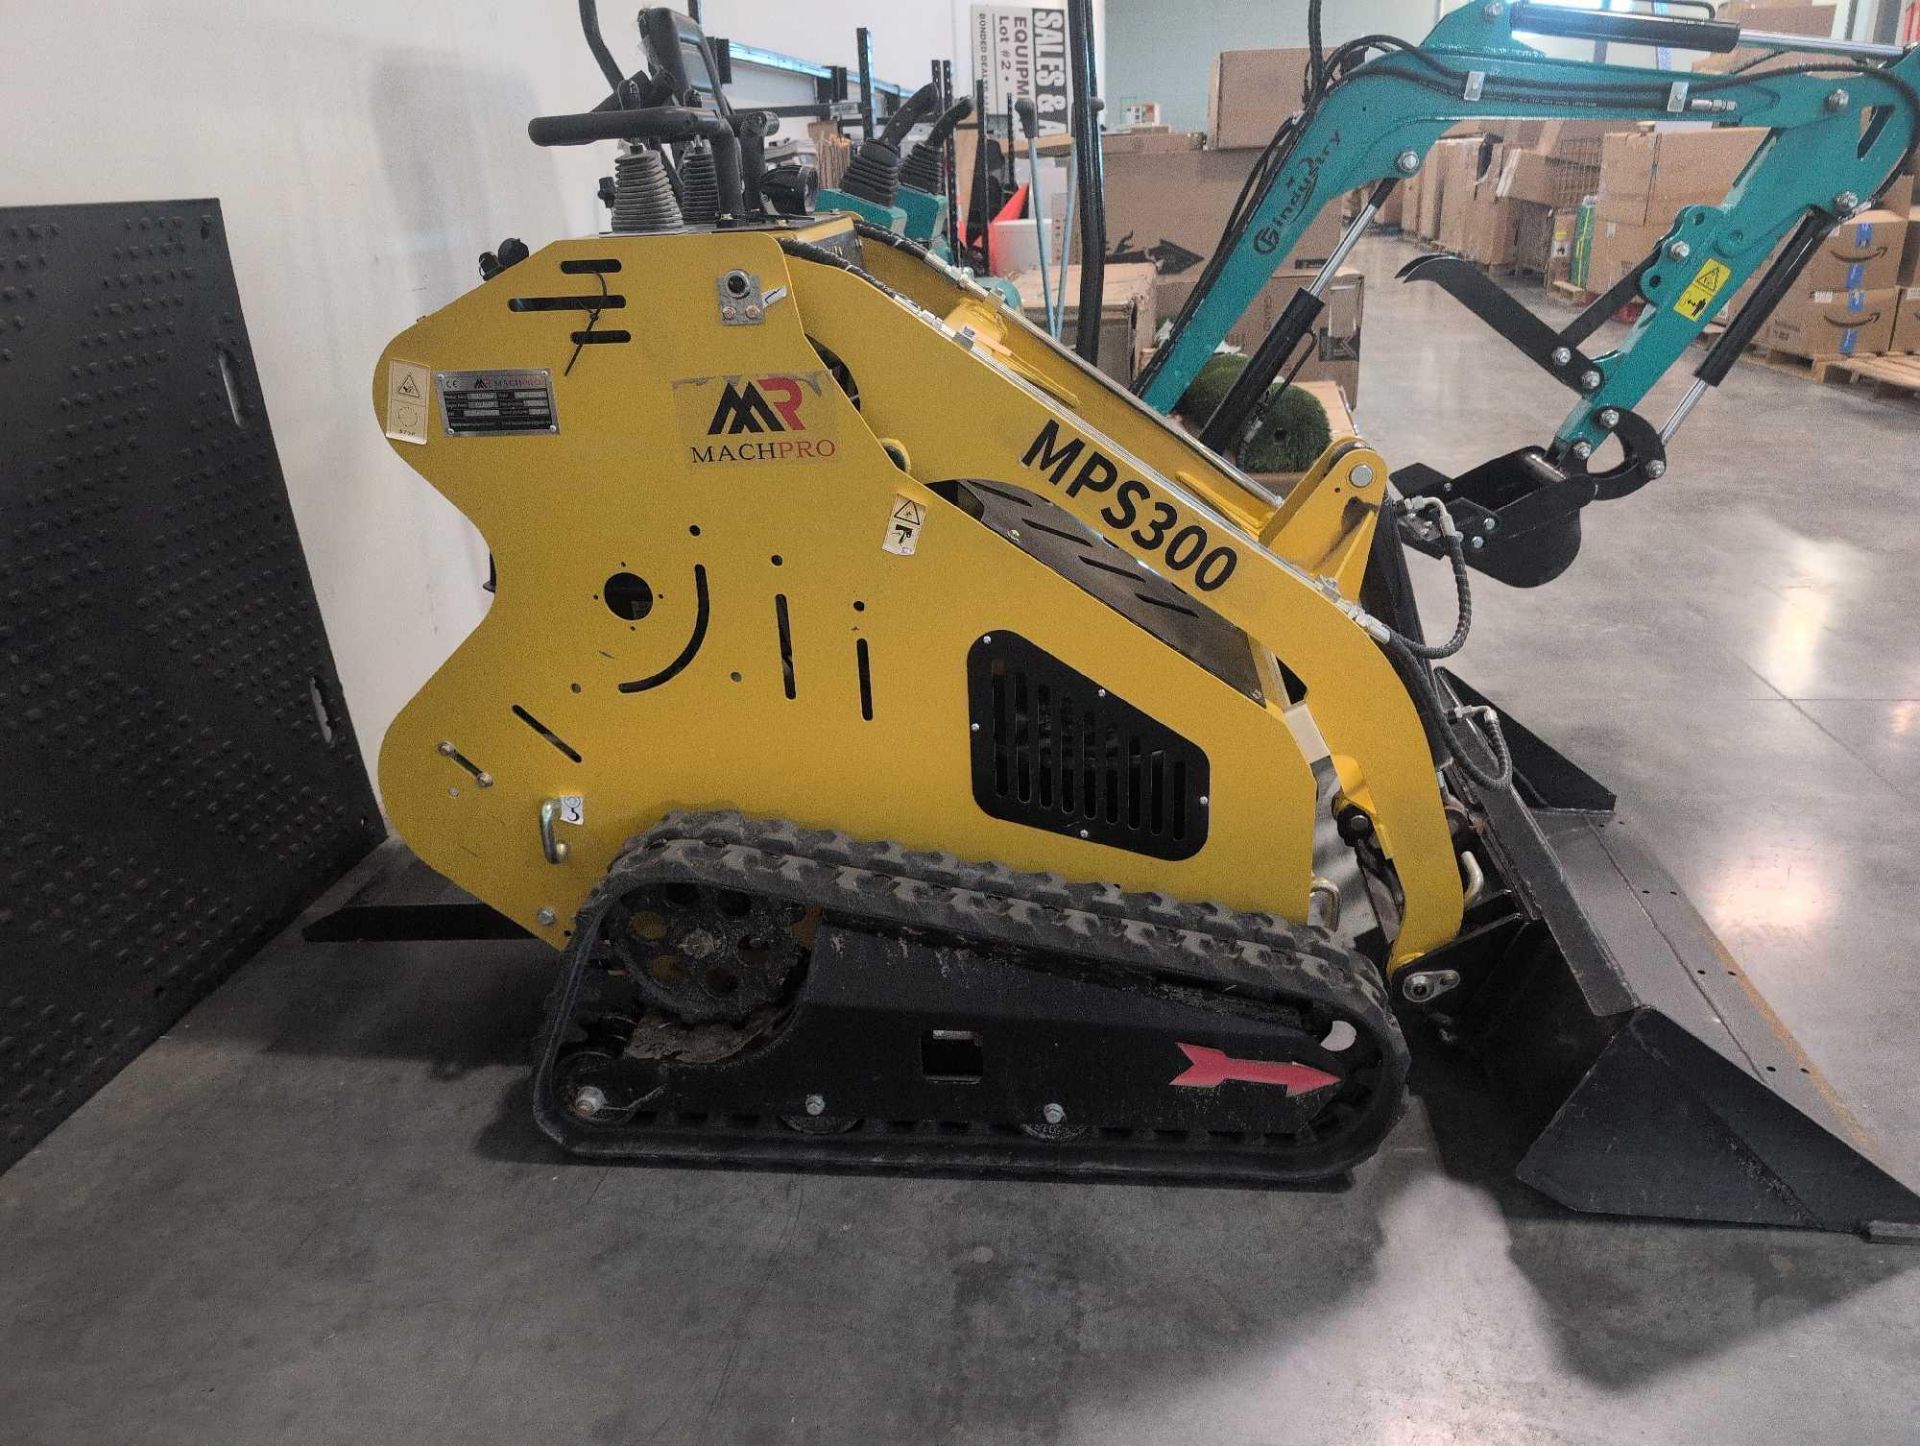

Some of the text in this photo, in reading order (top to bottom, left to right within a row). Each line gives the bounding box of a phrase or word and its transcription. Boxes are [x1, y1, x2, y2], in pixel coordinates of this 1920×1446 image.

[998, 16, 1010, 43] Lot
[1033, 10, 1065, 87] SALES
[1037, 94, 1066, 113] &
[690, 439, 836, 463] MACHPRO
[1020, 418, 1238, 592] MPS300
